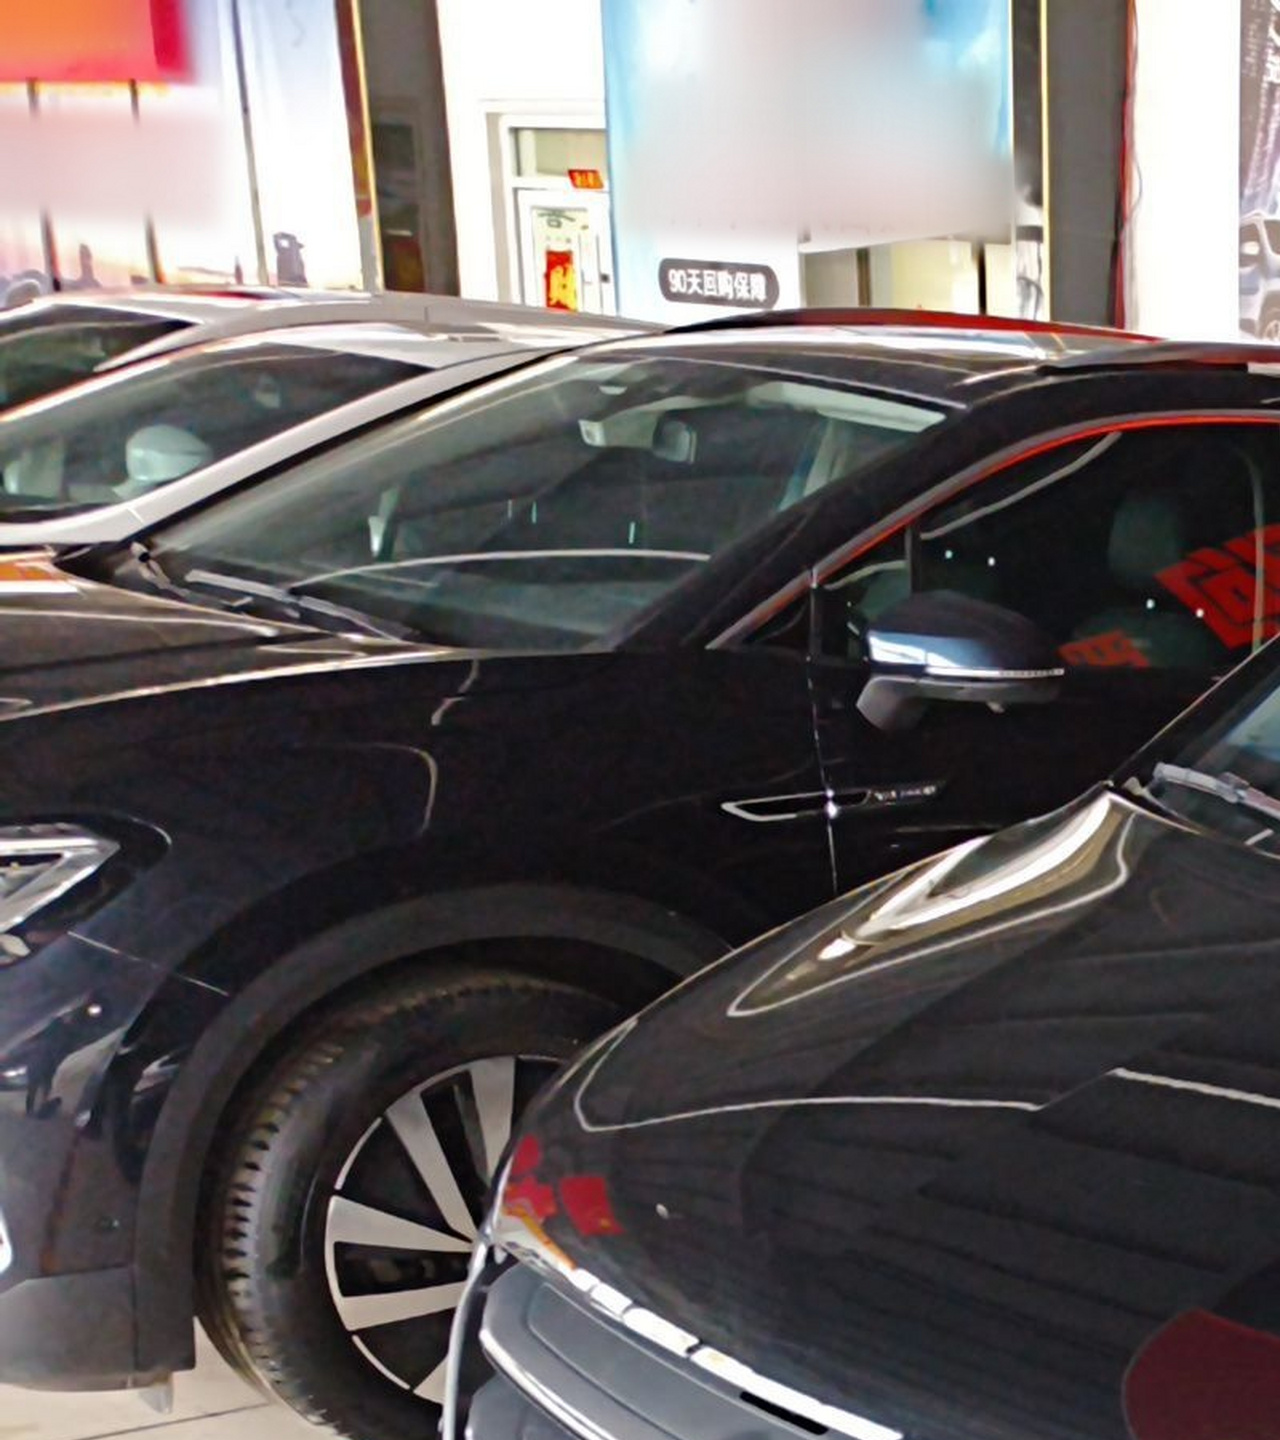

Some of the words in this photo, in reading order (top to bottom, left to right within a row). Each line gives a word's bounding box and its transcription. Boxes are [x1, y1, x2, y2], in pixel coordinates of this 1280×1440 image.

[668, 268, 766, 302] 90天回购保障
